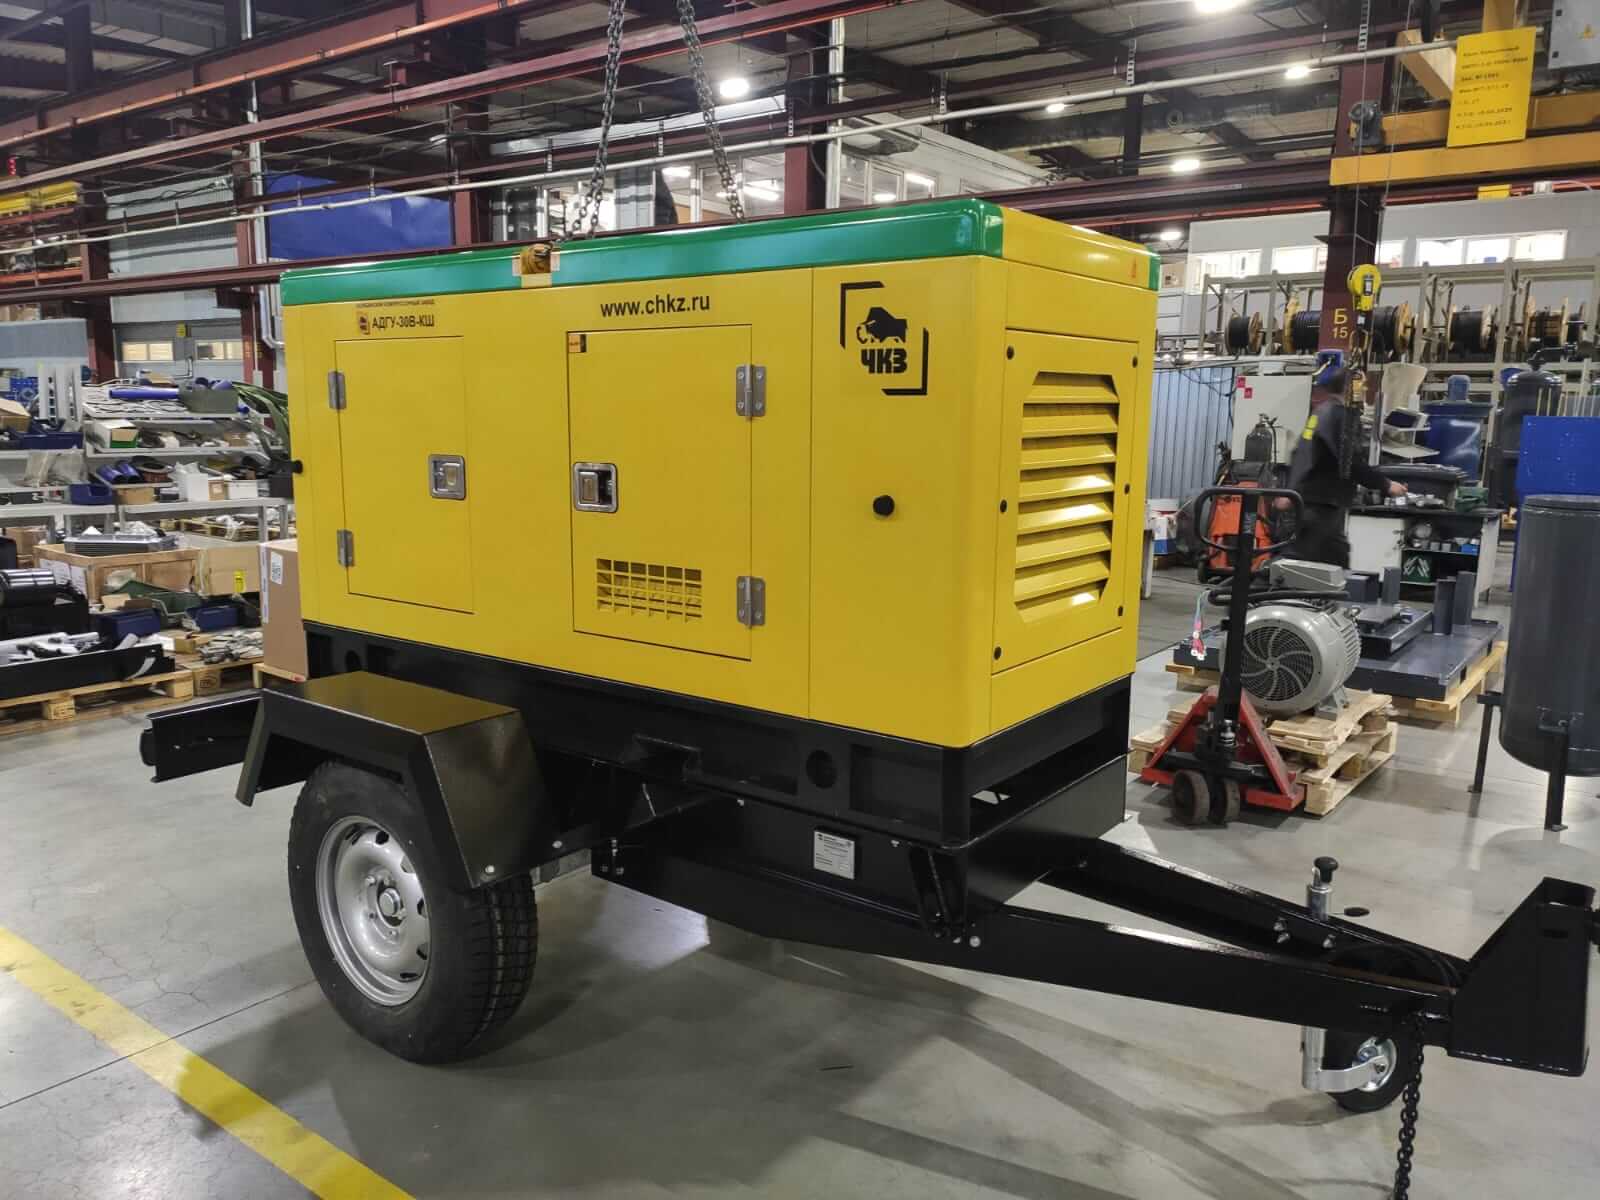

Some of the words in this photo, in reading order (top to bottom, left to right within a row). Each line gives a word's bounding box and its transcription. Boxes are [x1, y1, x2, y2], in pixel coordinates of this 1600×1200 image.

[600, 293, 710, 317] www.chkz.ru
[1333, 307, 1349, 325] Б
[1332, 326, 1349, 339] 15
[860, 347, 908, 374] ЧКЗ
